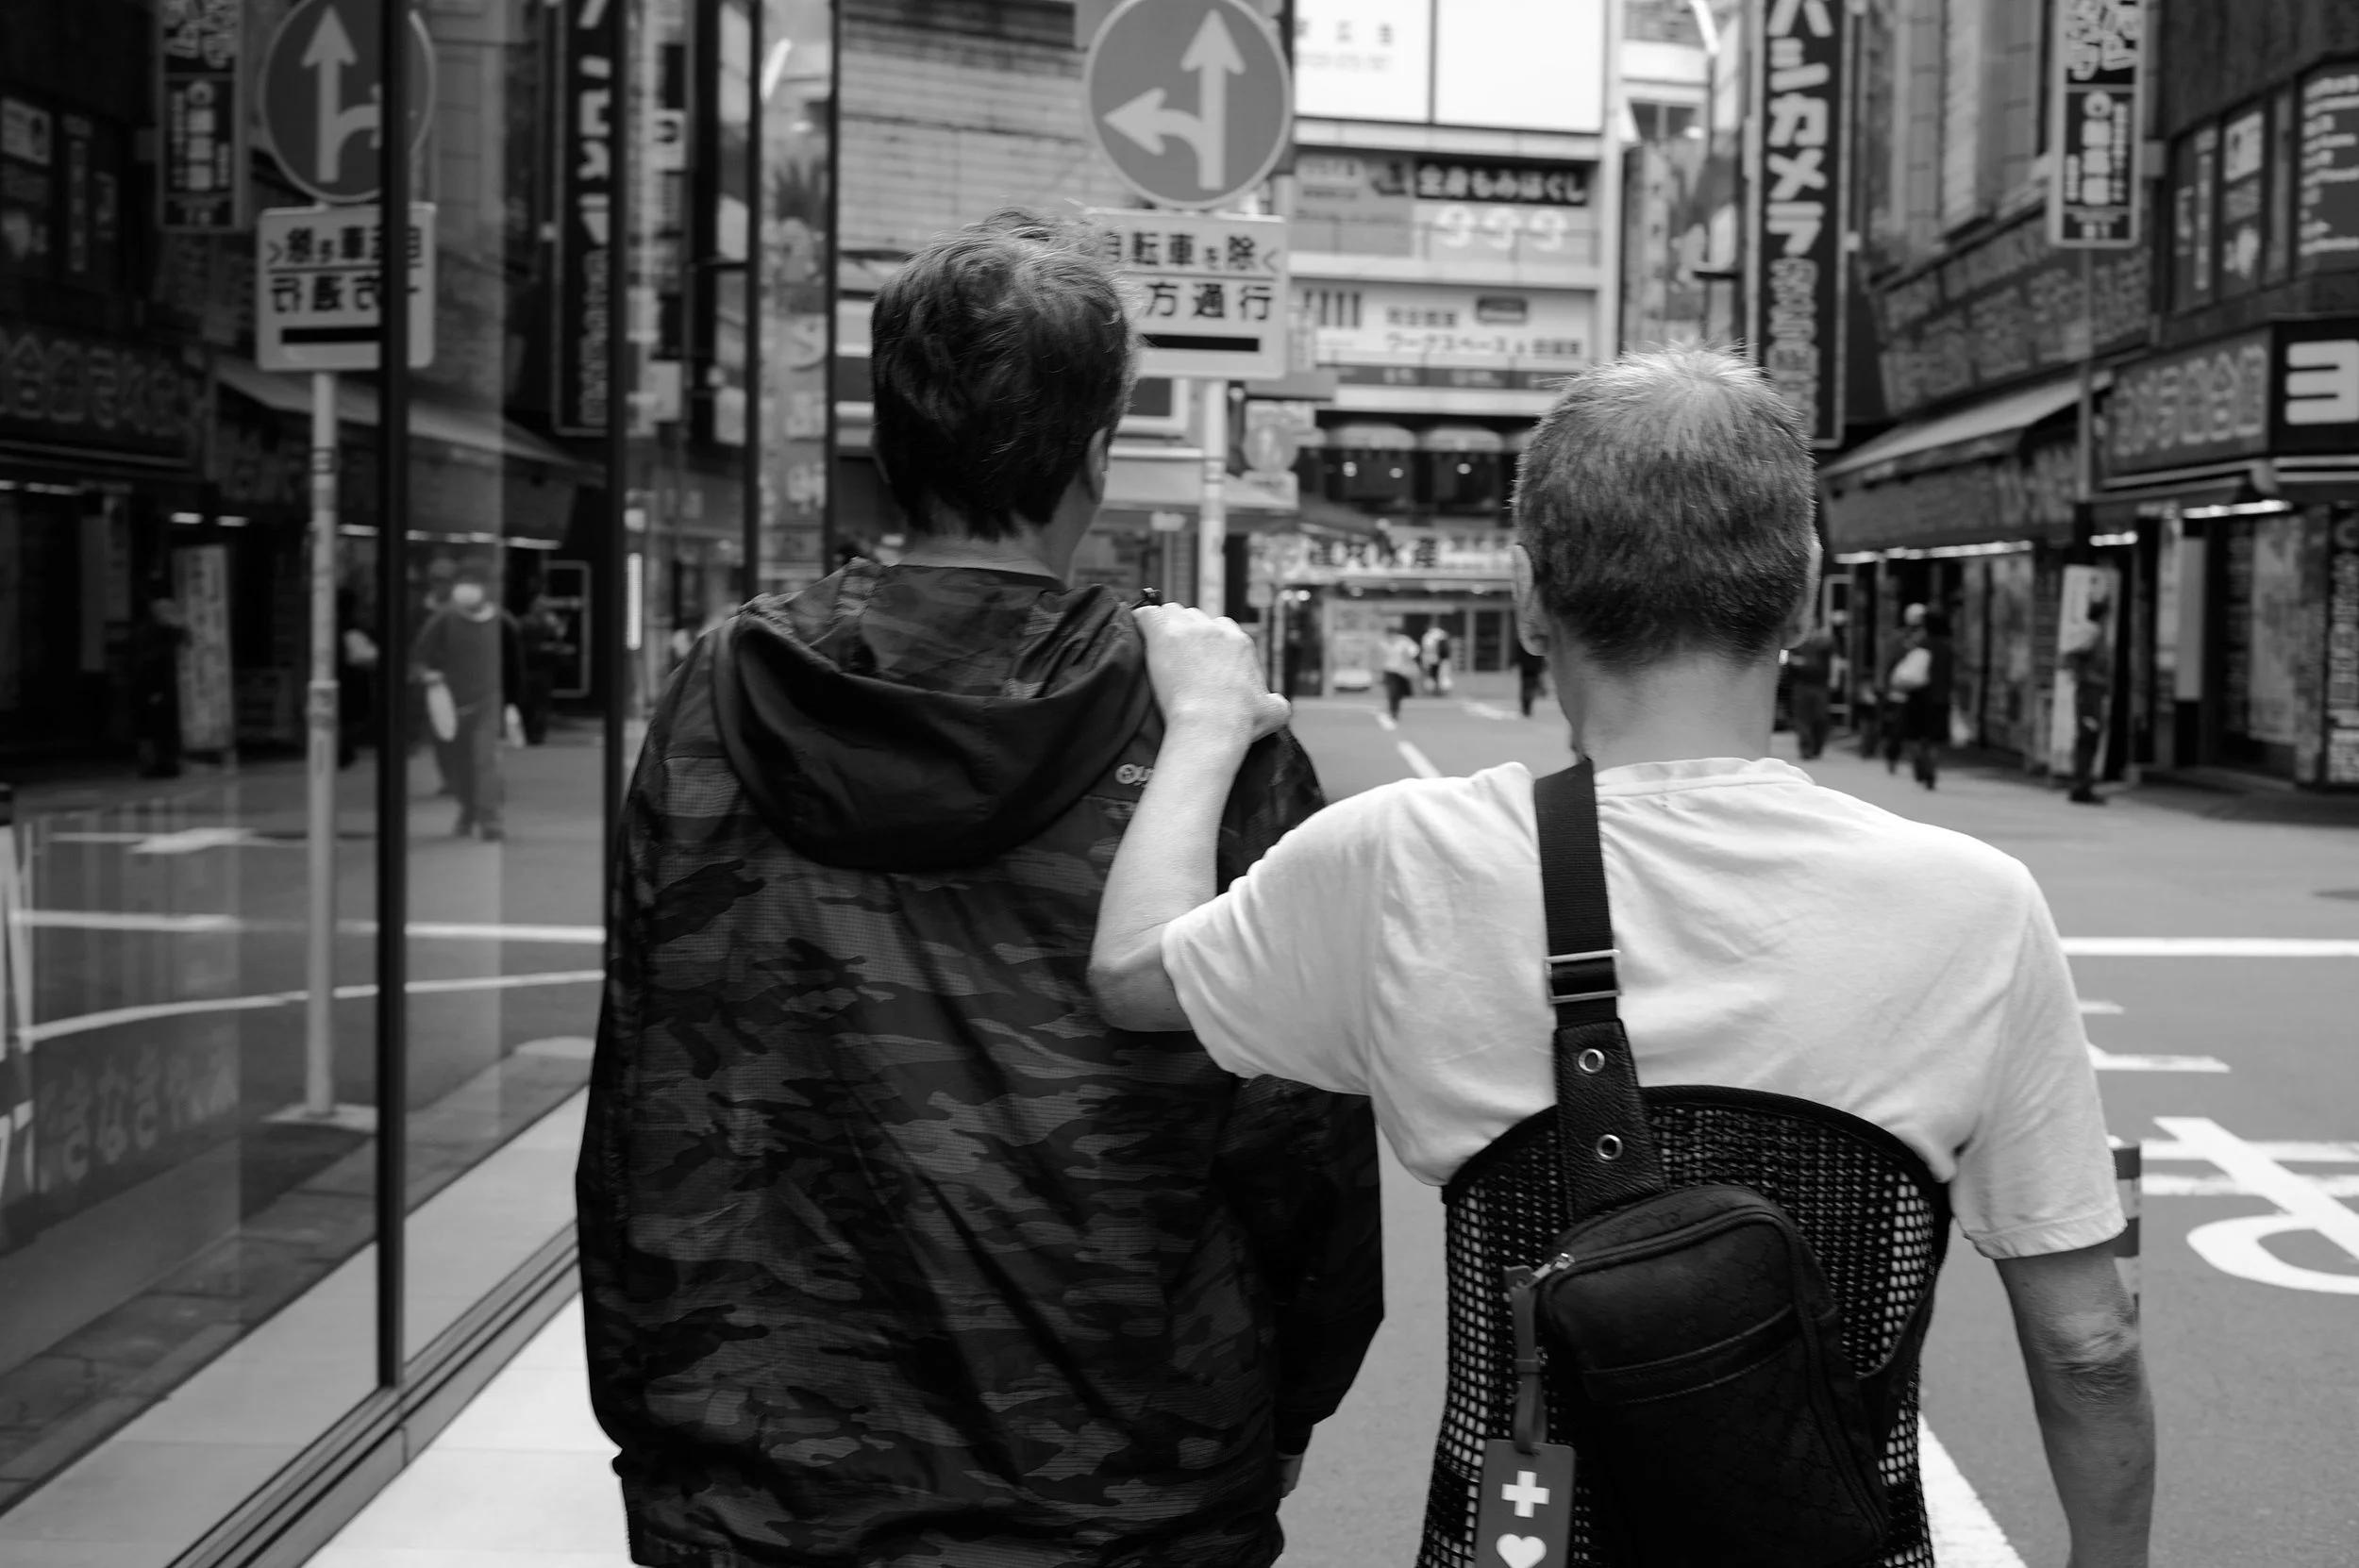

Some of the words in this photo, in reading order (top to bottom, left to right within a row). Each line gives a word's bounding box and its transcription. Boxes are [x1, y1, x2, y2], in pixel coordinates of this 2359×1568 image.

[1103, 231, 1280, 273] 自転車を除く
[1147, 282, 1273, 321] 方通行
